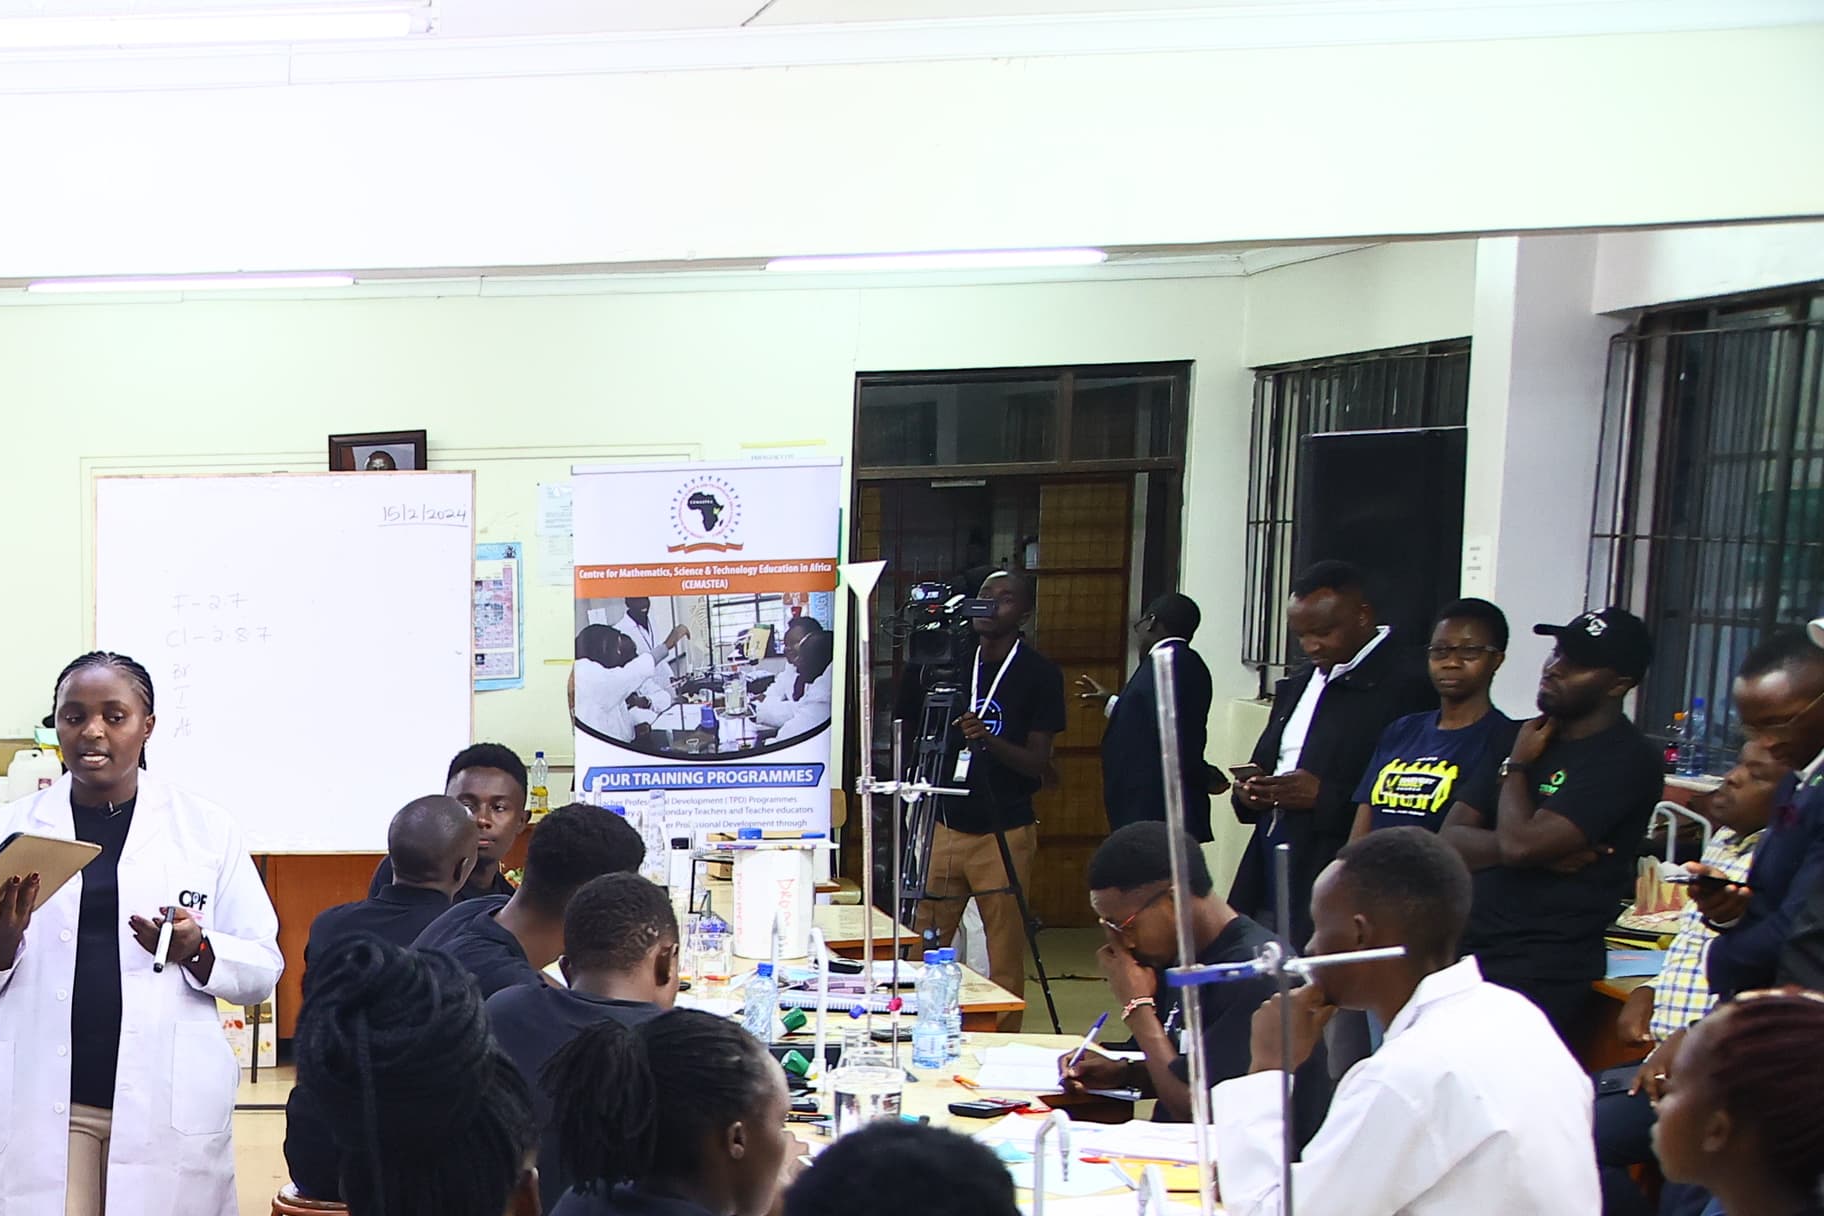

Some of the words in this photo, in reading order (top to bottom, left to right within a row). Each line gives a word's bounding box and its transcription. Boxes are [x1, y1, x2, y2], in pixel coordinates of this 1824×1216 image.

[579, 569, 605, 579] Centre
[606, 568, 618, 579] for
[618, 567, 673, 578] Mathematics,
[674, 566, 703, 576] Science
[704, 566, 711, 576] &
[713, 565, 756, 577] Technology
[759, 564, 799, 574] Education
[799, 563, 809, 572] in
[809, 562, 832, 573] Africa
[681, 579, 728, 591] (CEMASTEA)
[602, 773, 630, 787] OUR
[632, 771, 705, 785] TRAINING
[707, 769, 814, 784] PROGRAMMES
[671, 796, 724, 806] Development
[749, 795, 797, 805] Programmes
[695, 807, 727, 815] Teachers
[728, 807, 743, 815] and
[745, 806, 774, 814] Teacher
[776, 806, 814, 814] educators
[723, 819, 774, 829] Development
[775, 818, 807, 828] through
